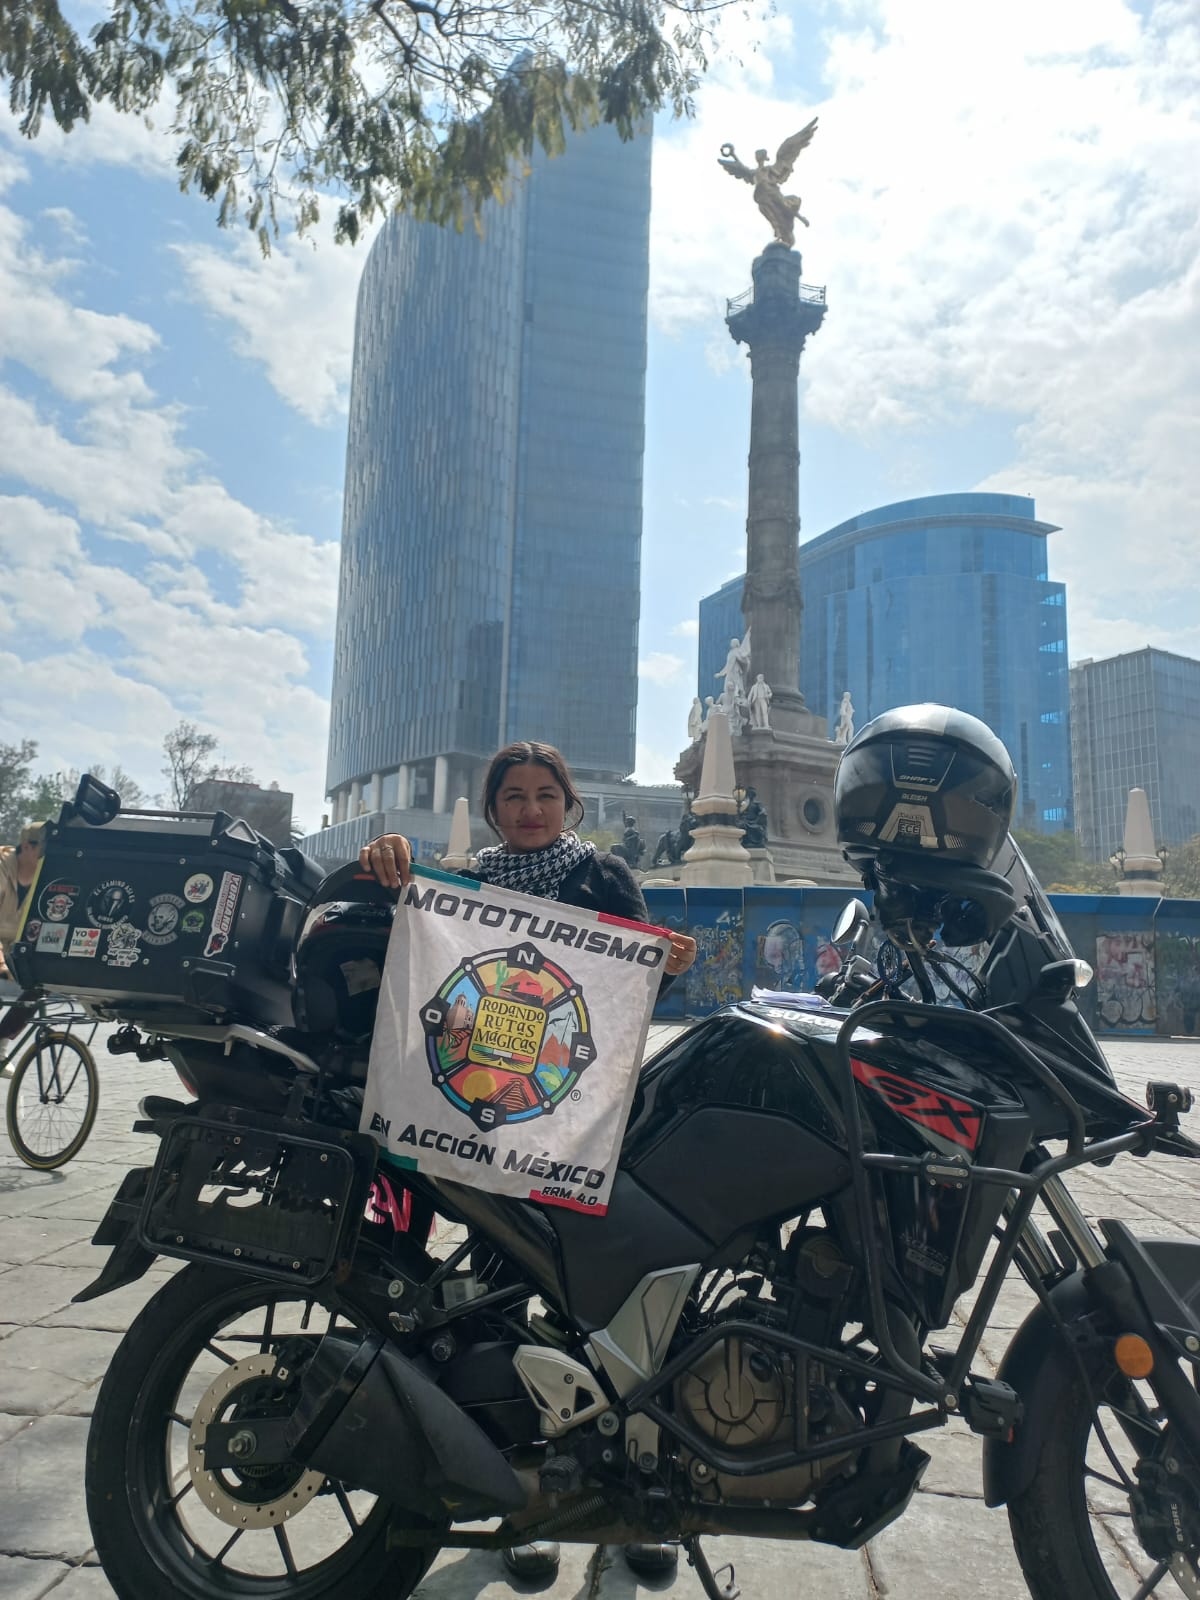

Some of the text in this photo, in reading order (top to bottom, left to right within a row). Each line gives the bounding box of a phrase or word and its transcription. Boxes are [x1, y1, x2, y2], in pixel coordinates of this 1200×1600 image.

[75, 930, 87, 938] YO
[404, 884, 664, 969] MOTOTURISMO
[516, 950, 536, 966] N
[425, 1009, 442, 1024] O
[575, 1046, 590, 1059] E
[869, 1075, 982, 1138] SX
[480, 1108, 496, 1123] S
[369, 1112, 605, 1189] EN ACCIÓN MÉXICO
[541, 1187, 597, 1206] RRM 4.0
